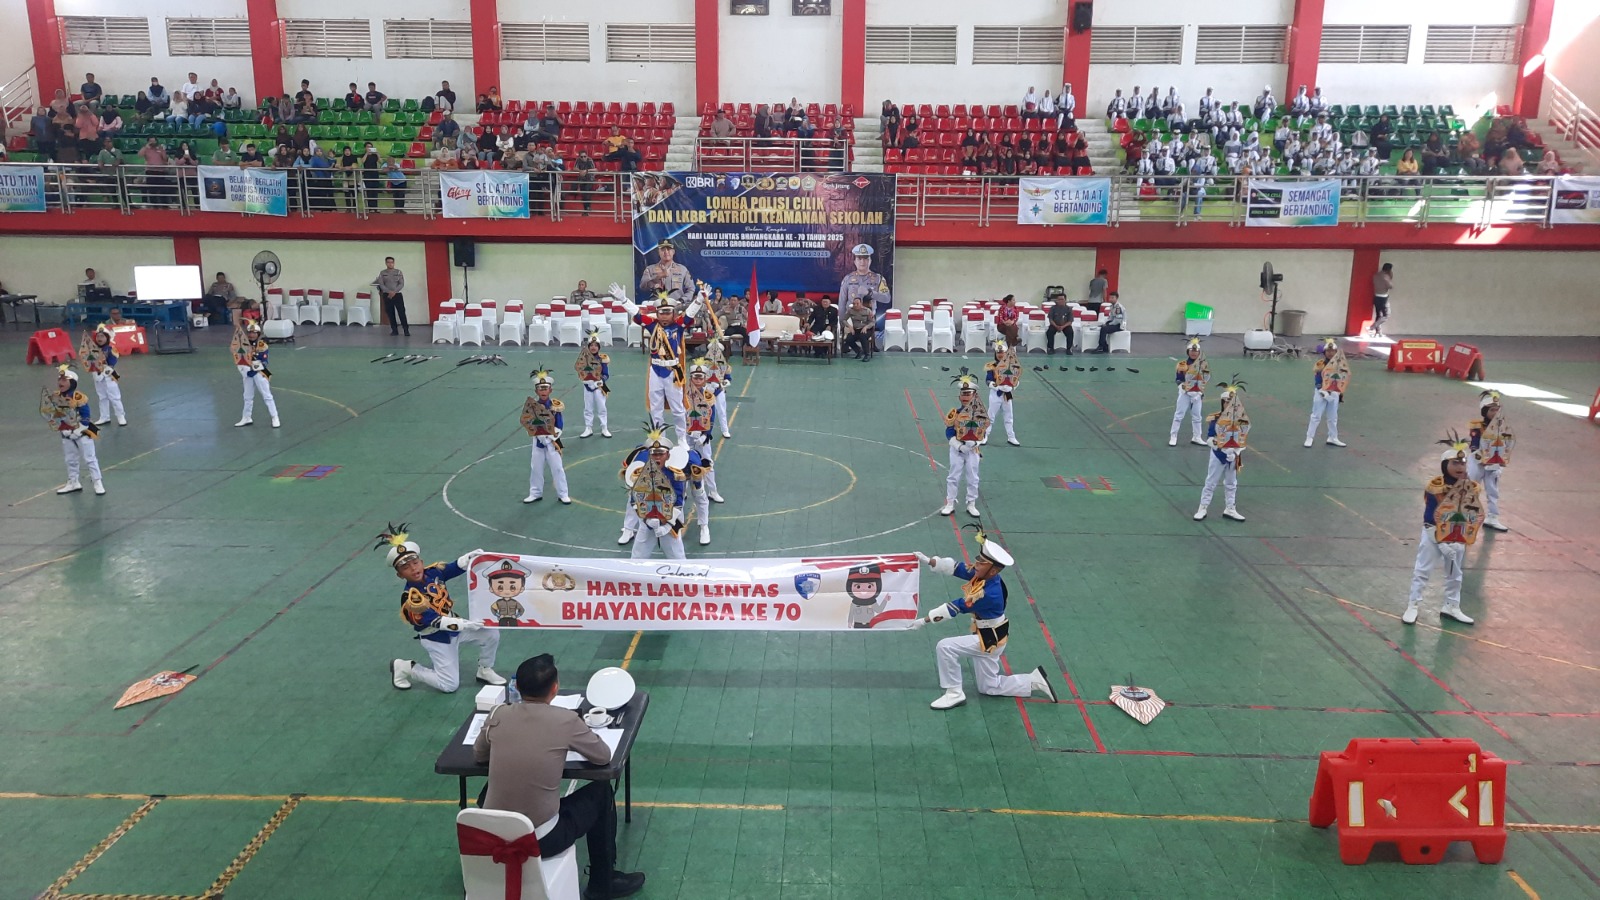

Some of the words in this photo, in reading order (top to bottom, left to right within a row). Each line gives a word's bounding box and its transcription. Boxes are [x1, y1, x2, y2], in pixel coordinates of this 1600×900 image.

[0, 175, 16, 187] ATU
[18, 175, 37, 187] TIM
[697, 177, 714, 187] BRI
[475, 183, 523, 194] SELAMAT
[248, 194, 270, 204] SUKSES
[1054, 189, 1104, 200] SELAMAT
[1287, 189, 1332, 202] SEMANGAT
[477, 195, 524, 206] BERTANDING
[706, 196, 748, 210] LOMBA
[750, 196, 789, 210] POLISI
[793, 196, 824, 210] CILIK
[1053, 202, 1102, 213] BERTANDING
[1283, 204, 1334, 216] BERTANDING
[648, 210, 672, 223] DAN
[675, 210, 707, 223] LKBB
[709, 210, 759, 224] PATROLI
[761, 210, 827, 224] KEAMANAN
[829, 211, 883, 225] SEKOLAH
[687, 232, 702, 240] HARI
[703, 232, 718, 240] LALU
[798, 233, 805, 241] 70
[806, 233, 826, 241] TAHUN
[827, 233, 844, 241] 2025
[729, 240, 763, 248] GROBOGAN
[587, 580, 643, 596] HARI
[647, 583, 699, 597] LALU
[703, 583, 779, 597] LINTAS
[562, 602, 735, 620] BHAYANGKARA
[741, 603, 768, 621] KE
[773, 603, 801, 621] 70
